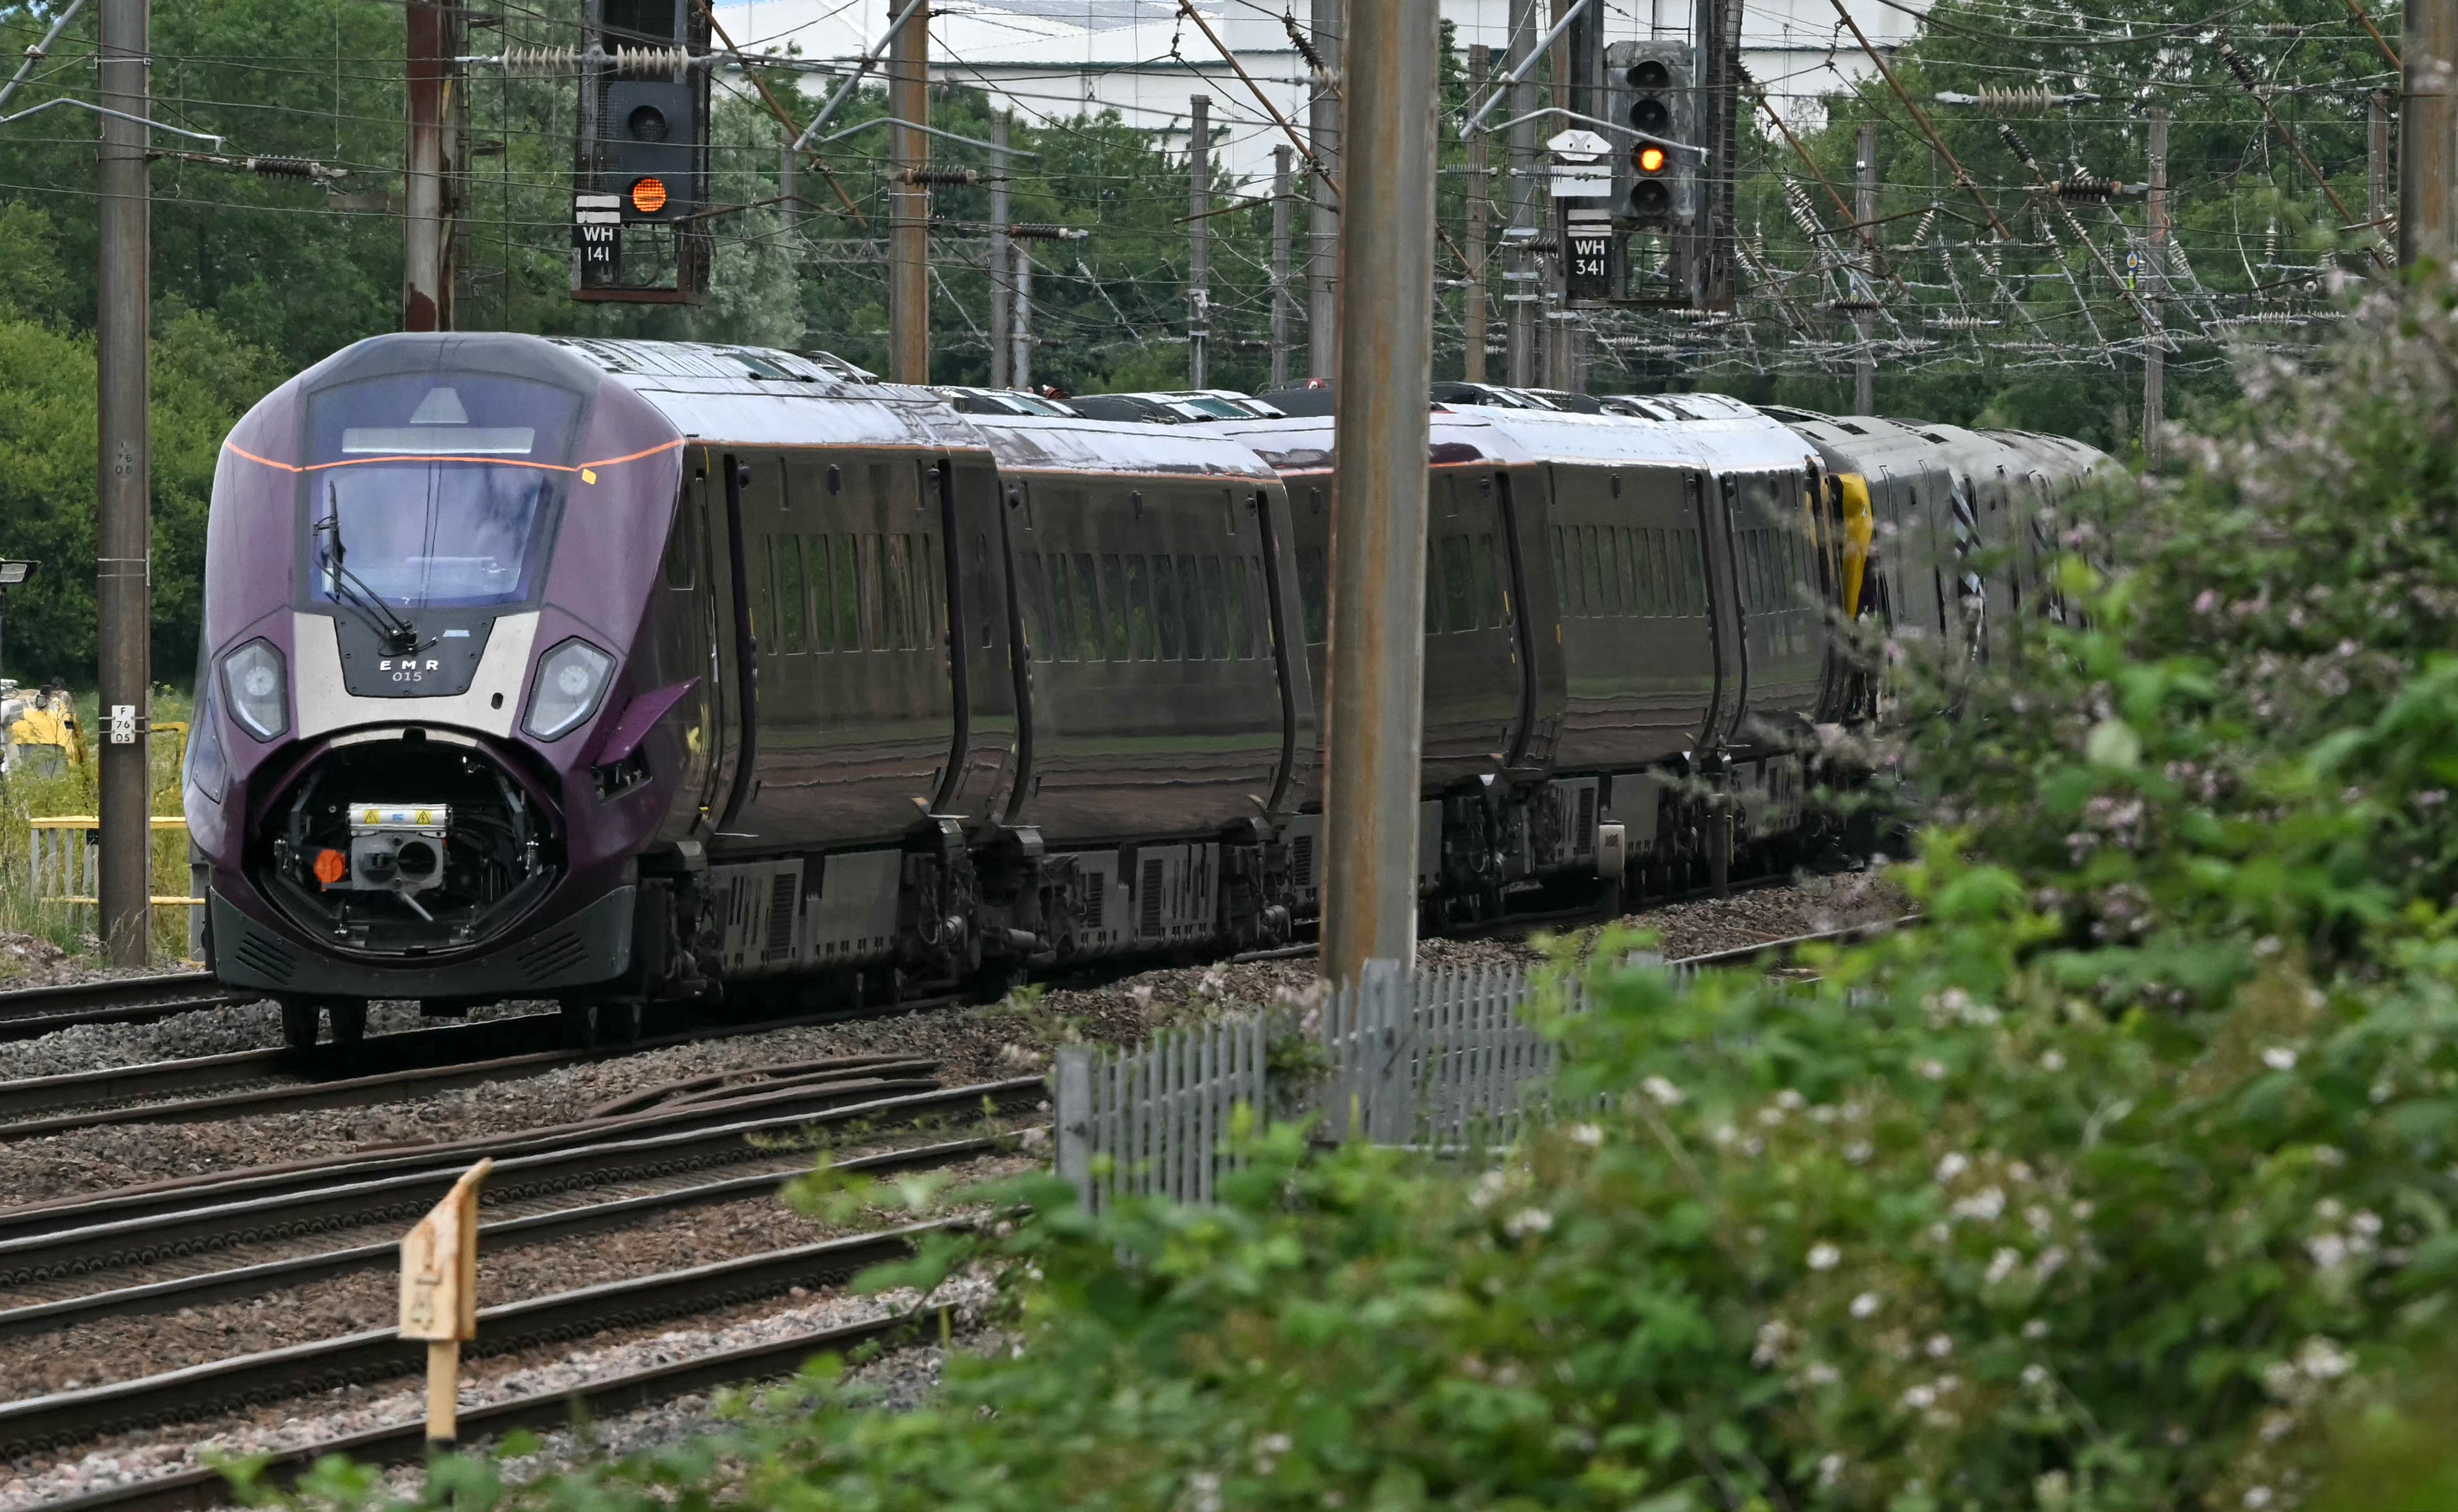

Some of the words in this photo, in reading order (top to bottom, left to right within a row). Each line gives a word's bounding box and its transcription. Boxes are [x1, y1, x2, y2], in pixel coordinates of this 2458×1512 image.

[583, 227, 613, 241] WH
[588, 246, 609, 261] 141
[1575, 240, 1605, 255] WH
[1576, 260, 1604, 276] 341
[392, 671, 422, 681] 015
[120, 707, 126, 715] F
[116, 733, 130, 742] 05
